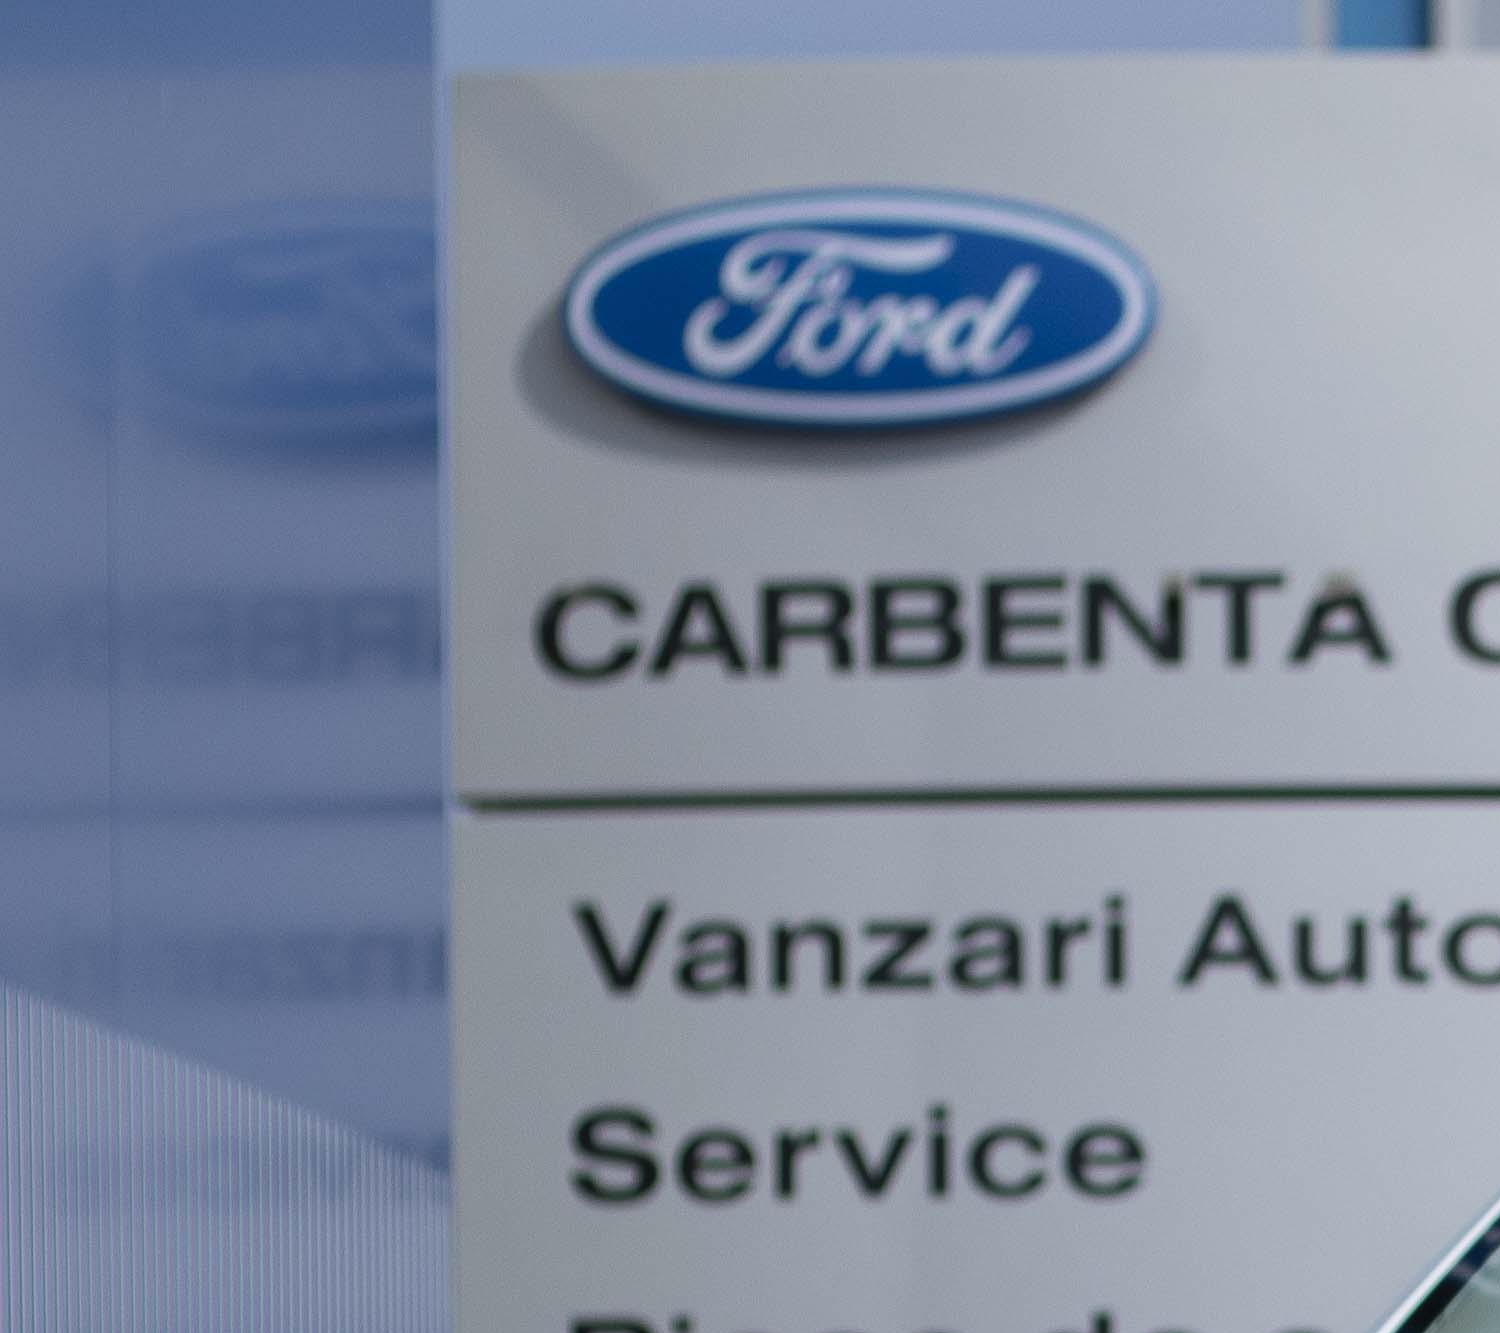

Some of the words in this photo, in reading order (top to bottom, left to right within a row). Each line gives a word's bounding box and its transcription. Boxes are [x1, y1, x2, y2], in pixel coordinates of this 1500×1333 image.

[682, 228, 1042, 378] Ford
[533, 567, 1394, 684] CARBENTA
[570, 893, 1127, 996] Vanzari
[568, 1100, 1146, 1206] Service
